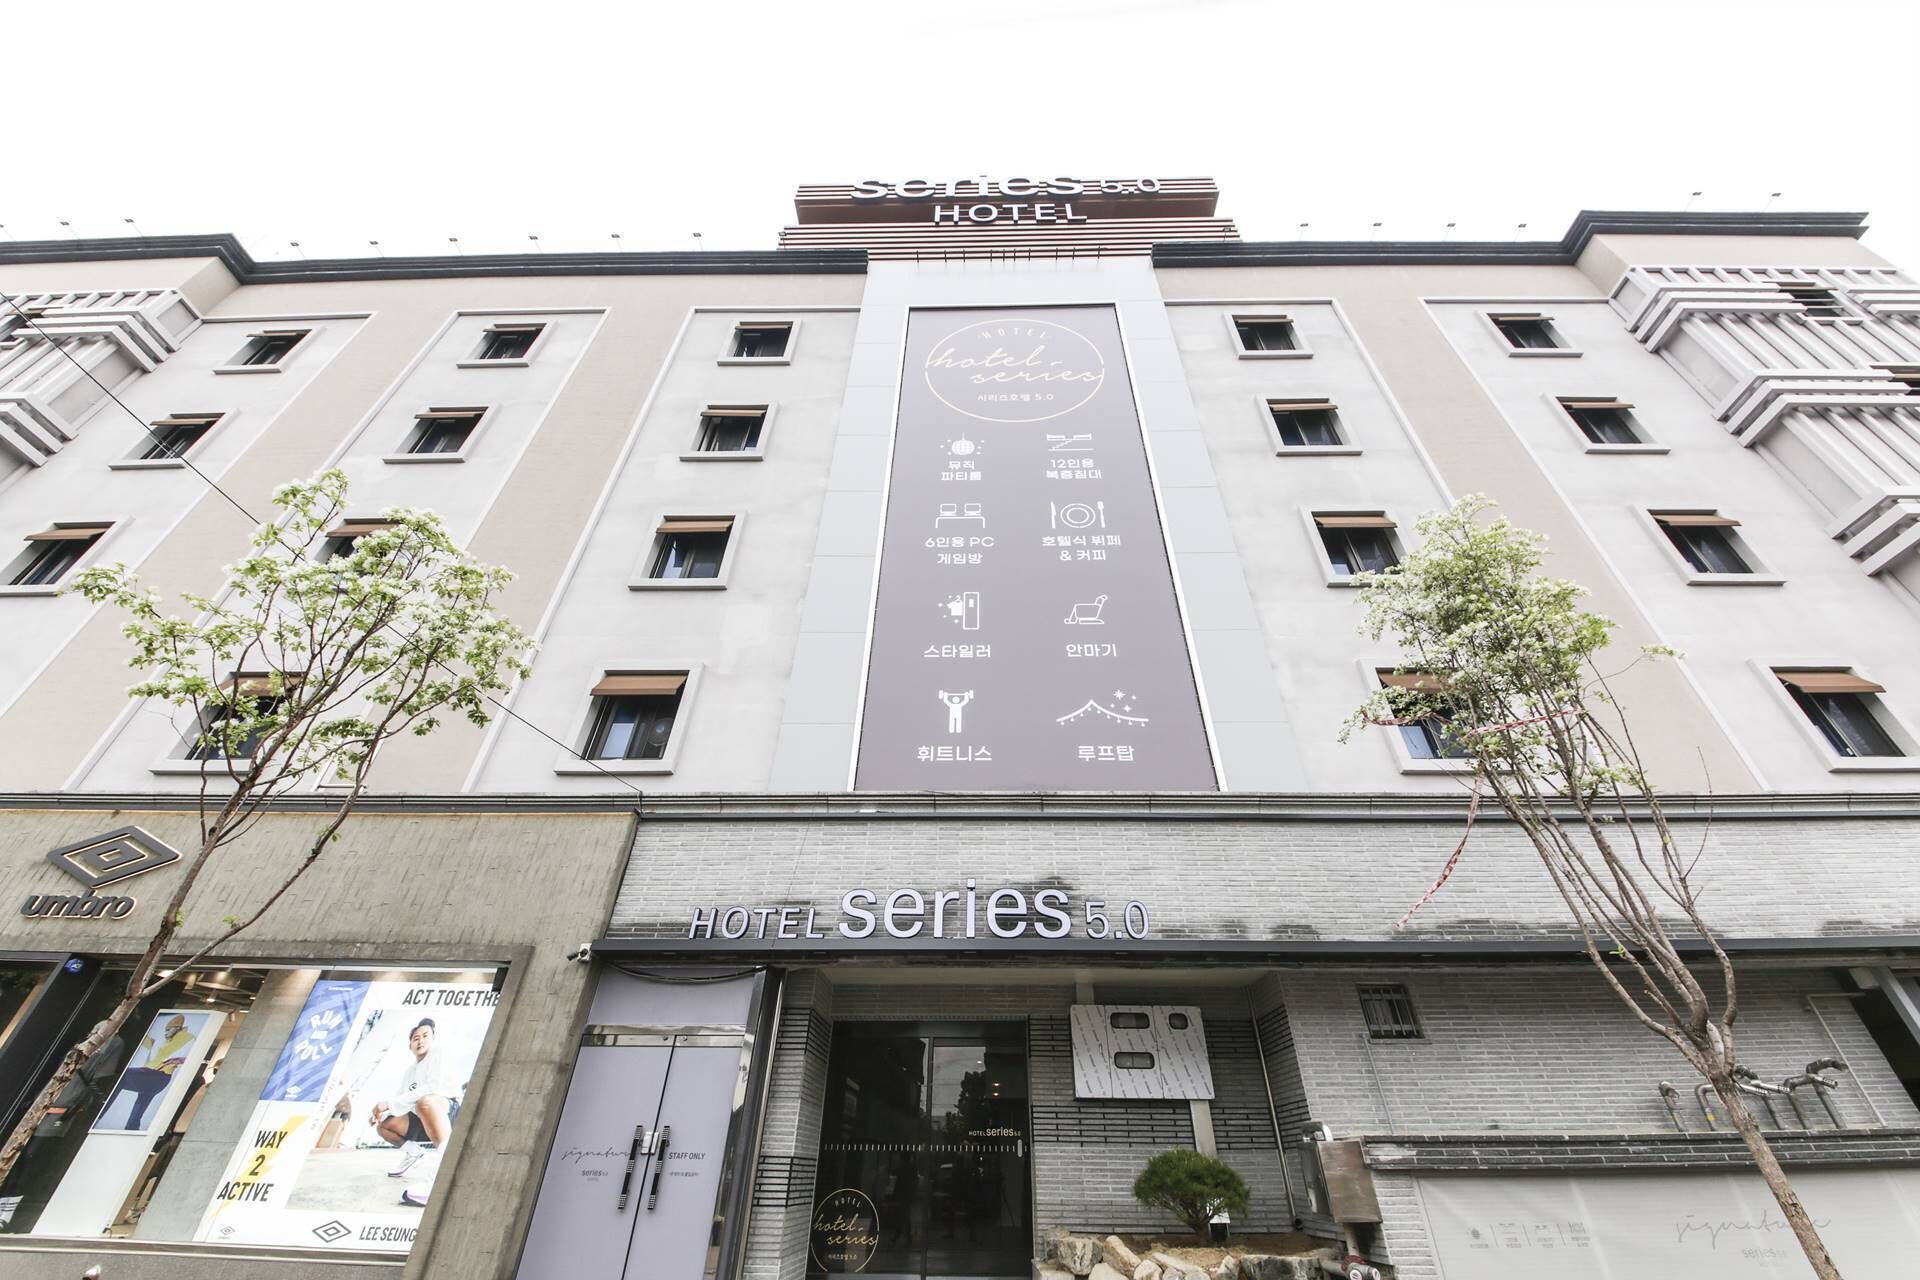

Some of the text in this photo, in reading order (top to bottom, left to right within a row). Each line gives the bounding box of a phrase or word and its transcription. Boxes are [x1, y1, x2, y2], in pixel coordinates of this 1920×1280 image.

[850, 174, 1162, 199] series 5.0
[934, 203, 1087, 224] HOTEL
[981, 328, 1046, 339] HOTEL
[928, 345, 1045, 368] hotel
[970, 362, 1103, 383] series
[1035, 393, 1054, 401] 5.0
[948, 460, 975, 470] 뮤직
[1050, 458, 1094, 469] 12인용
[925, 536, 996, 548] 6인용 PC
[1041, 535, 1122, 547] 호텔식 뷔페
[937, 552, 983, 565] 게임방
[1059, 549, 1106, 561] & 커피
[923, 644, 991, 658] 스타일러
[1065, 643, 1117, 658] 안마기
[917, 745, 992, 762] 휘트니스
[1078, 745, 1135, 762] 루프탑
[20, 889, 137, 919] umbro
[688, 878, 1150, 939] HOTEL series 5.0
[402, 988, 435, 1005] ACT
[986, 1126, 1014, 1136] series
[254, 1130, 288, 1148] WAY
[668, 1152, 706, 1160] STAFF ONLY
[248, 1154, 266, 1176] 2
[216, 1181, 274, 1202] ACTIVE
[359, 1226, 418, 1242] LEE SEUNG
[826, 1231, 879, 1246] series
